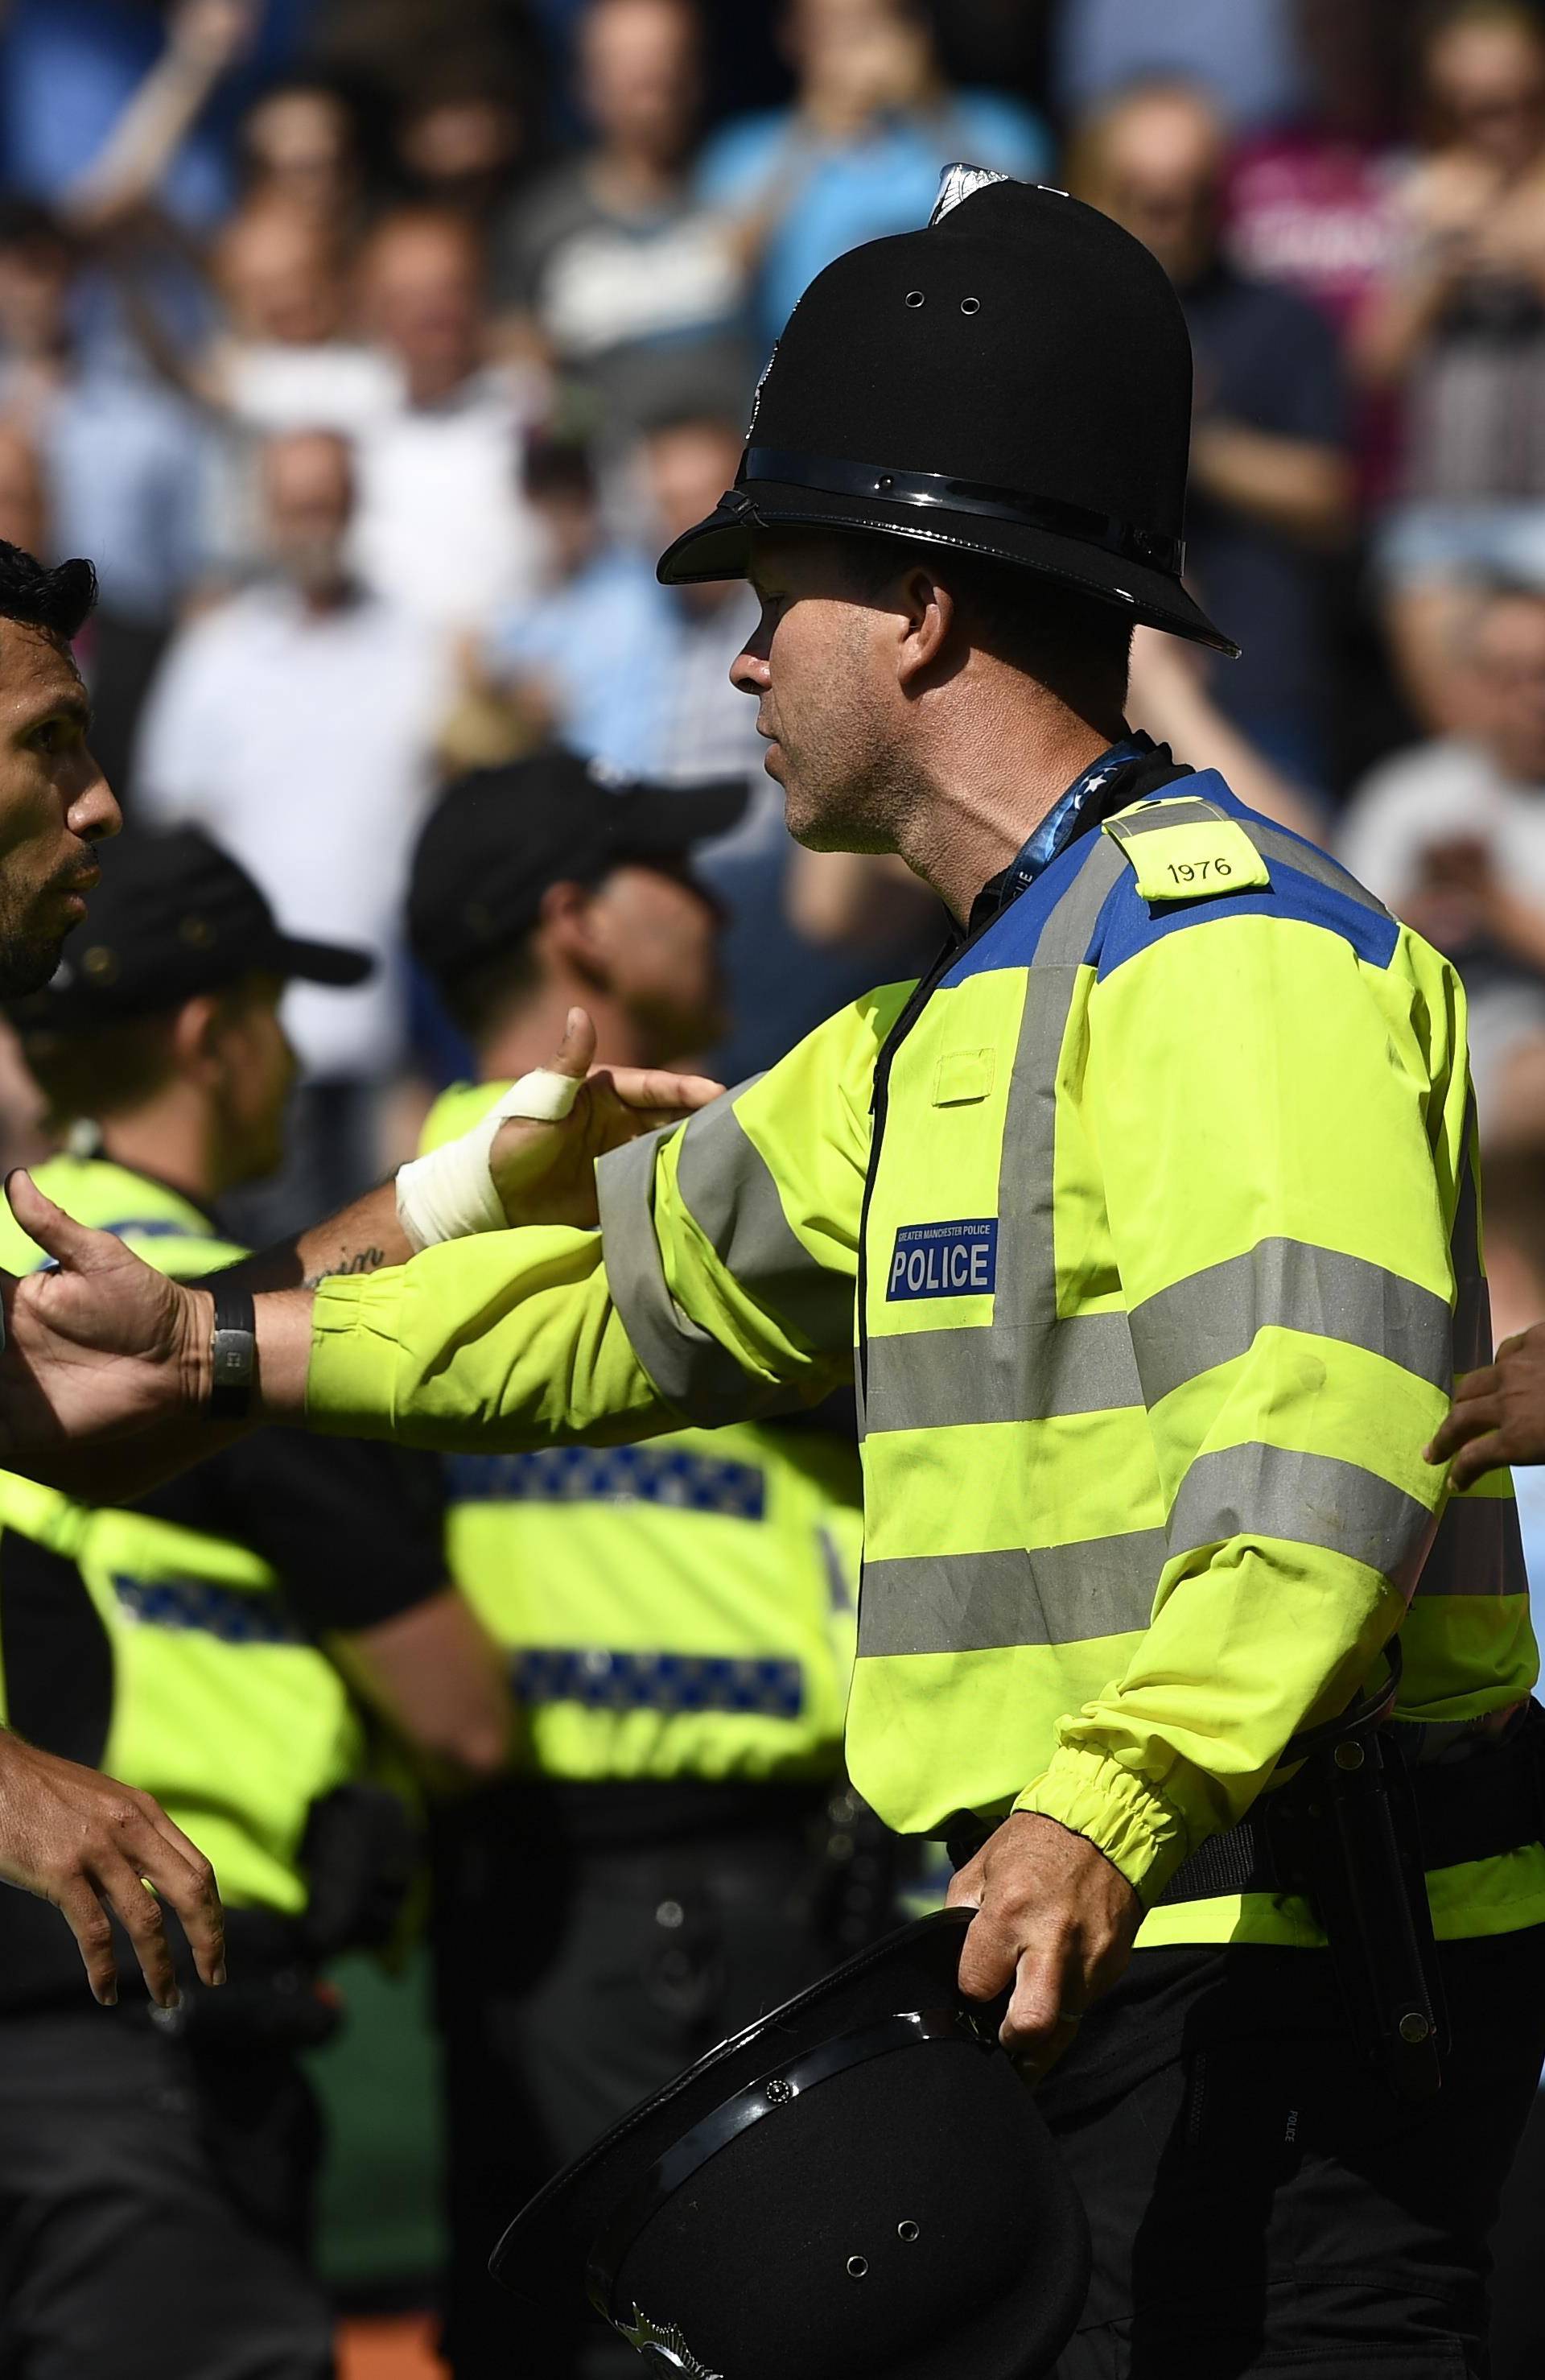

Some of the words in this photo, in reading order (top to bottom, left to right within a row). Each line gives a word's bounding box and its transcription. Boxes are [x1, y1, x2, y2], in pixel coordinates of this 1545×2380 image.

[1167, 858, 1232, 884] 1976
[898, 1231, 923, 1243] GREATER
[923, 1226, 962, 1239] MANCHESTER
[963, 1224, 991, 1235] POLICE
[890, 1244, 990, 1293] POLICE
[1285, 2110, 1299, 2143] POLICE
